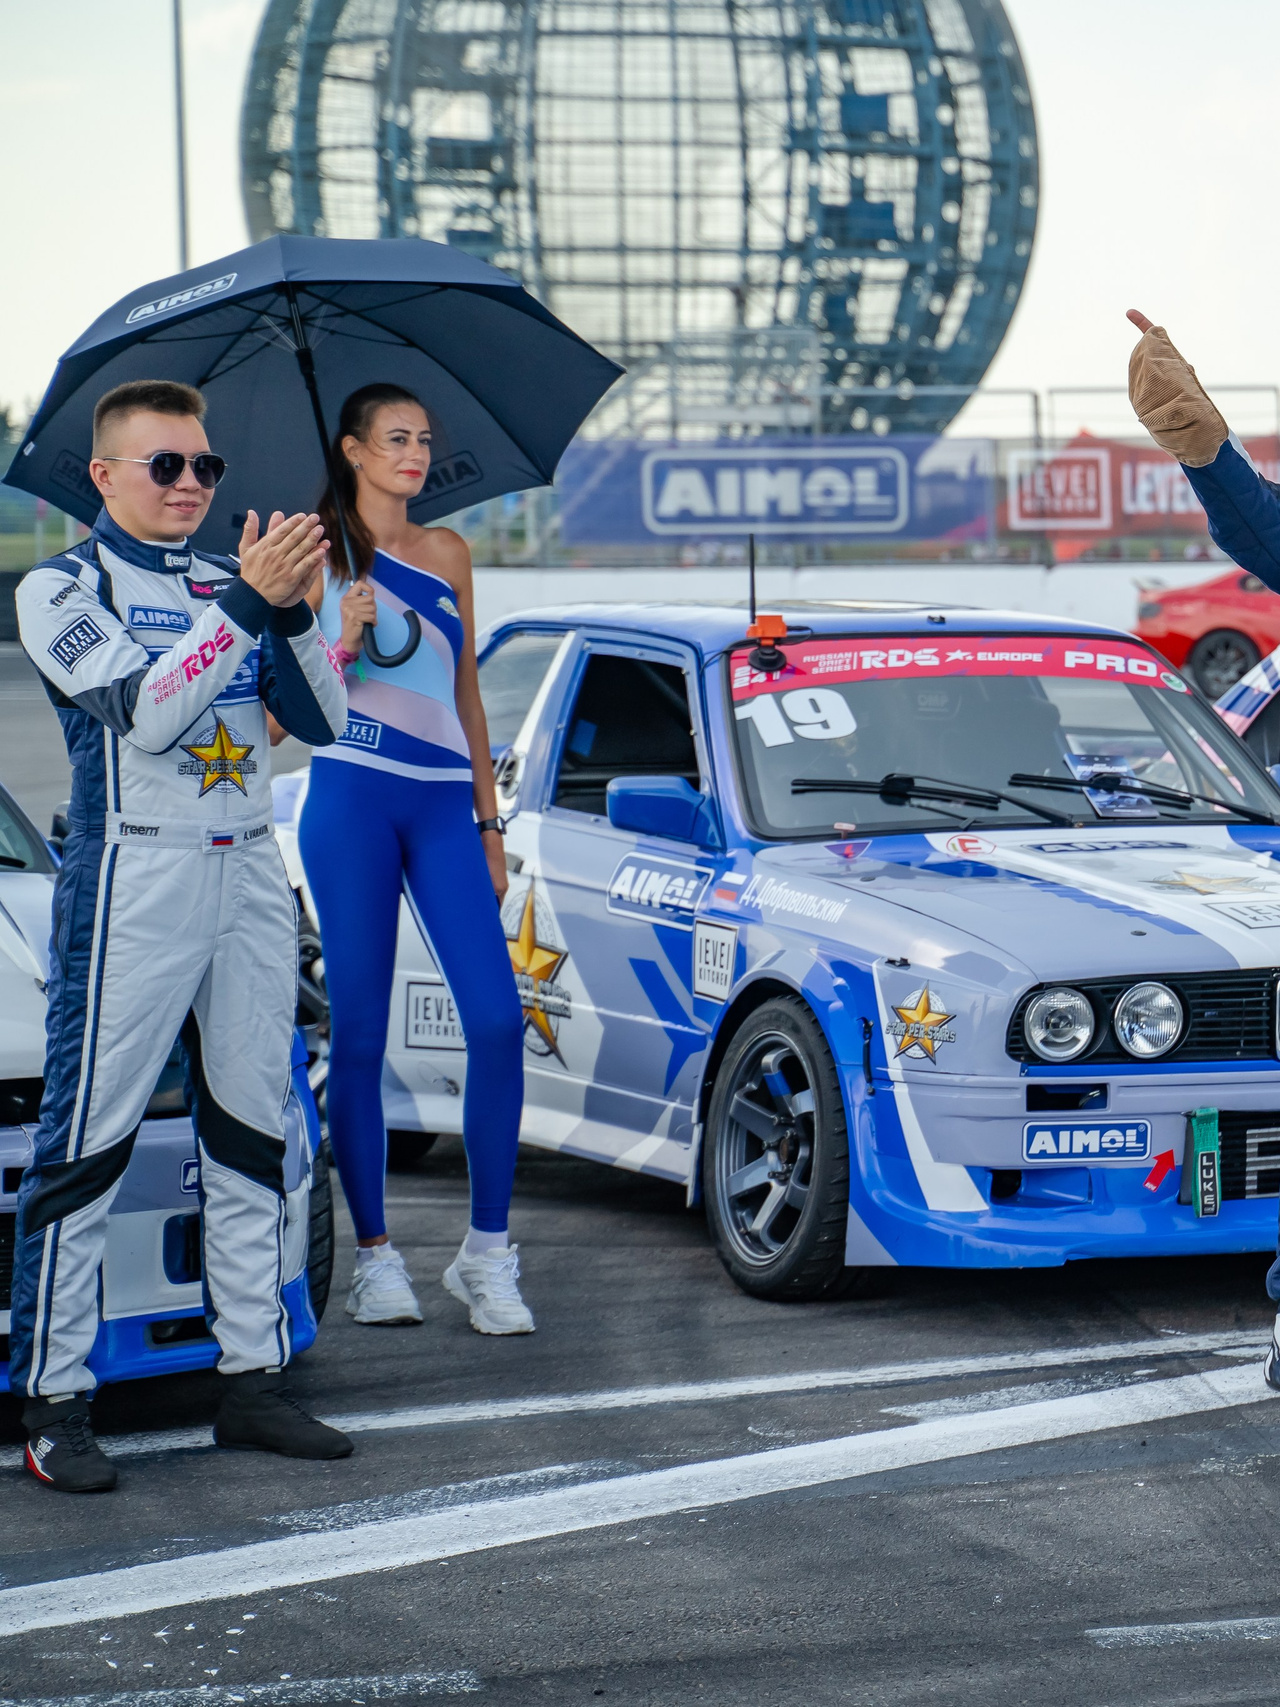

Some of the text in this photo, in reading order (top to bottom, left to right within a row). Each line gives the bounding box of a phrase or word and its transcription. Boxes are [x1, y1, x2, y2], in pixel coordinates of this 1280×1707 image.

[656, 466, 897, 516] AIMOL
[180, 621, 235, 684] RDS
[803, 652, 852, 663] RUSSIAN
[818, 658, 851, 667] DRIFT
[859, 648, 1157, 678] RDS EUROPE PRO
[811, 665, 851, 675] SERIES
[735, 687, 857, 748] 19
[119, 822, 160, 838] freem
[609, 865, 699, 916] AIMOL
[1028, 1129, 1145, 1154] AIMOL
